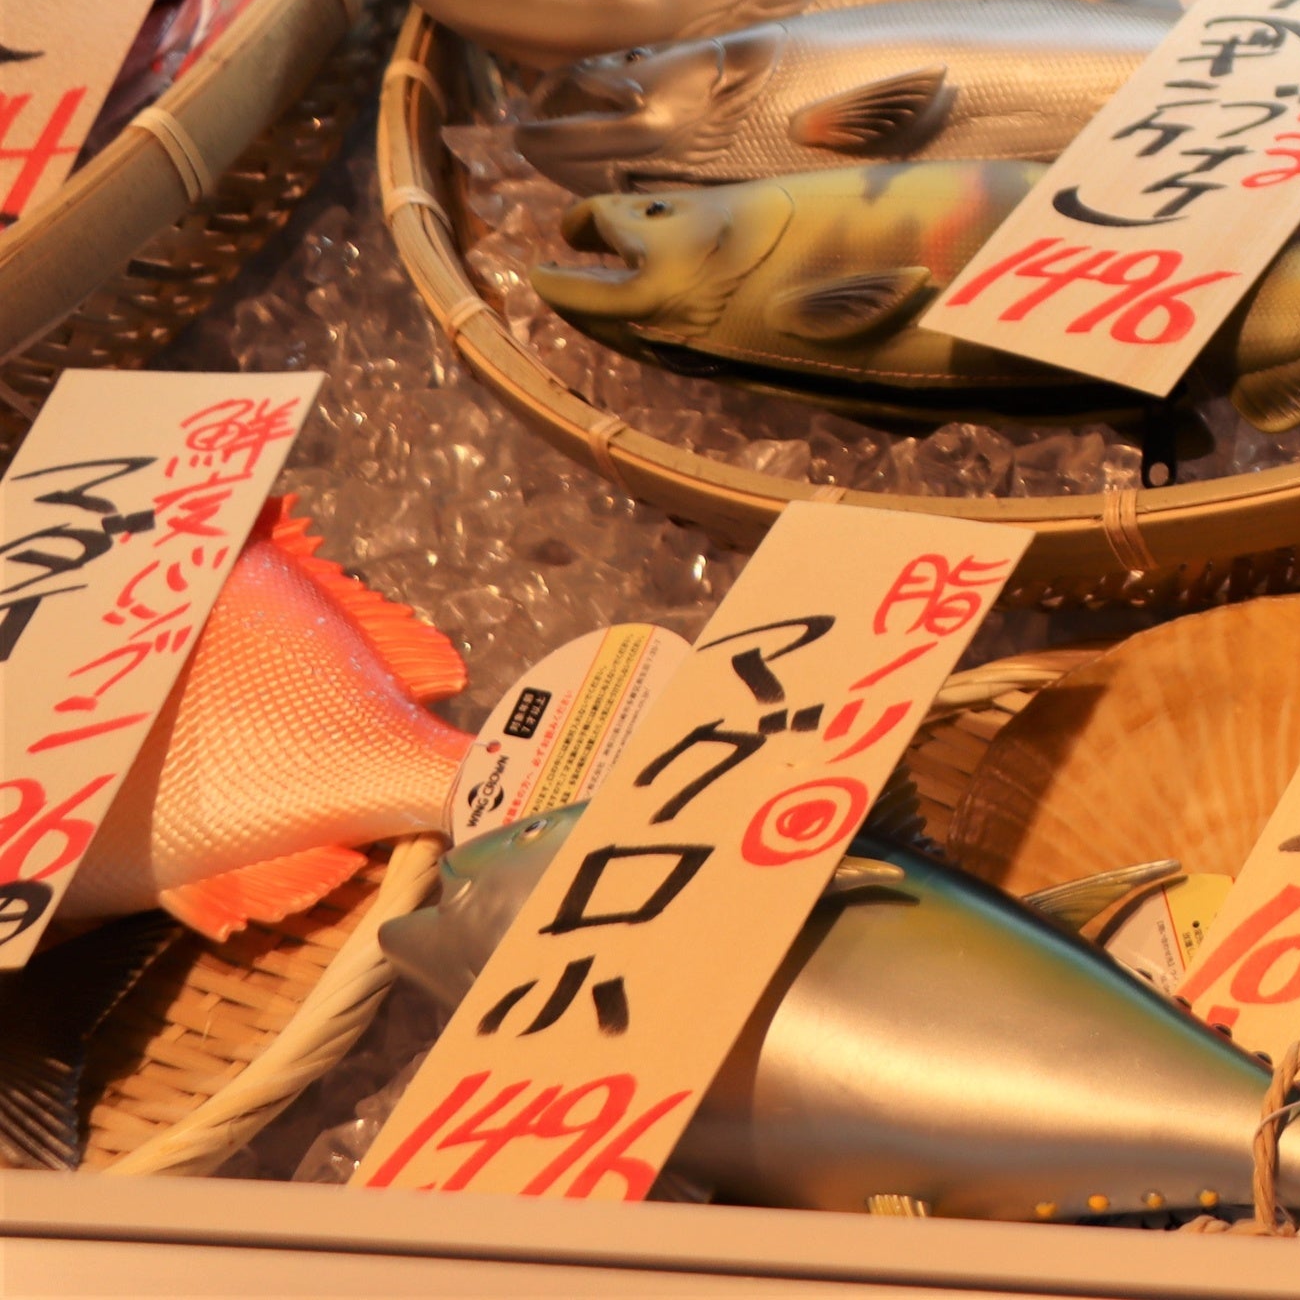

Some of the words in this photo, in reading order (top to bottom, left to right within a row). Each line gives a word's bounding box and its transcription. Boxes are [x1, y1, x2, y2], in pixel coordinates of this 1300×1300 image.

[946, 237, 1242, 345] 1496
[27, 398, 302, 754] 鮮度バツグン
[466, 792, 491, 829] WING
[481, 752, 510, 798] CROWN
[477, 613, 836, 1037] マグロ小
